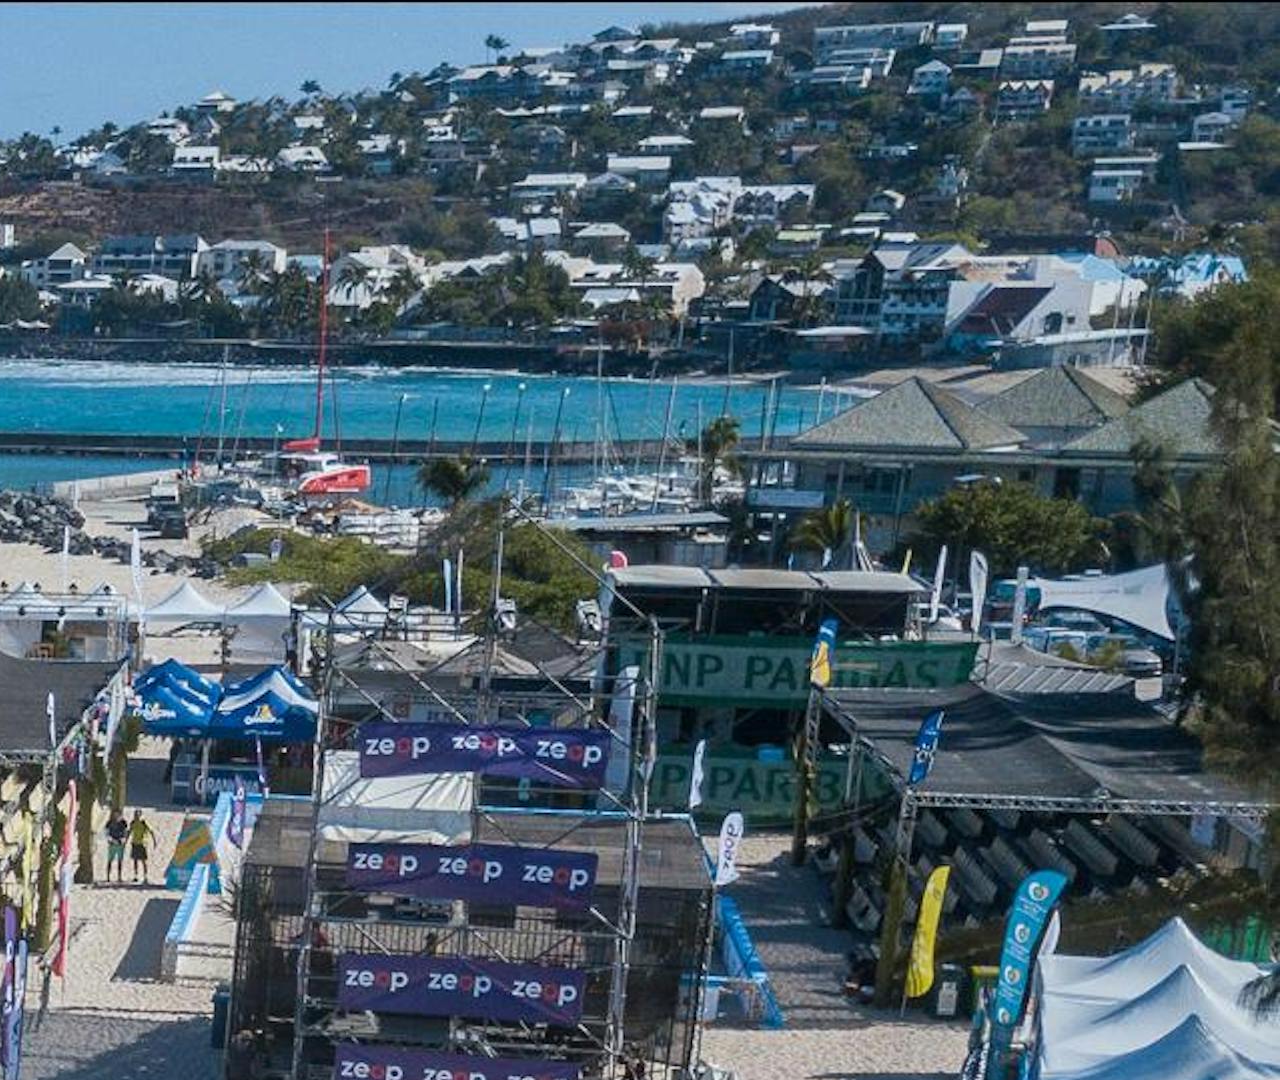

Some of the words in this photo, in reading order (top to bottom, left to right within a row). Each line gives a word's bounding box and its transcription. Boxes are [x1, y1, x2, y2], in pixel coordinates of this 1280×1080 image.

[745, 655, 938, 689] PABAS
[365, 736, 430, 759] zeop
[452, 734, 517, 757] zeop
[536, 740, 602, 767] zeop
[353, 852, 418, 876] zeop
[439, 854, 503, 883] zeop
[522, 863, 589, 891] zeop
[345, 969, 408, 992] zeop
[428, 971, 491, 997] zeop
[511, 979, 578, 1006] zeop
